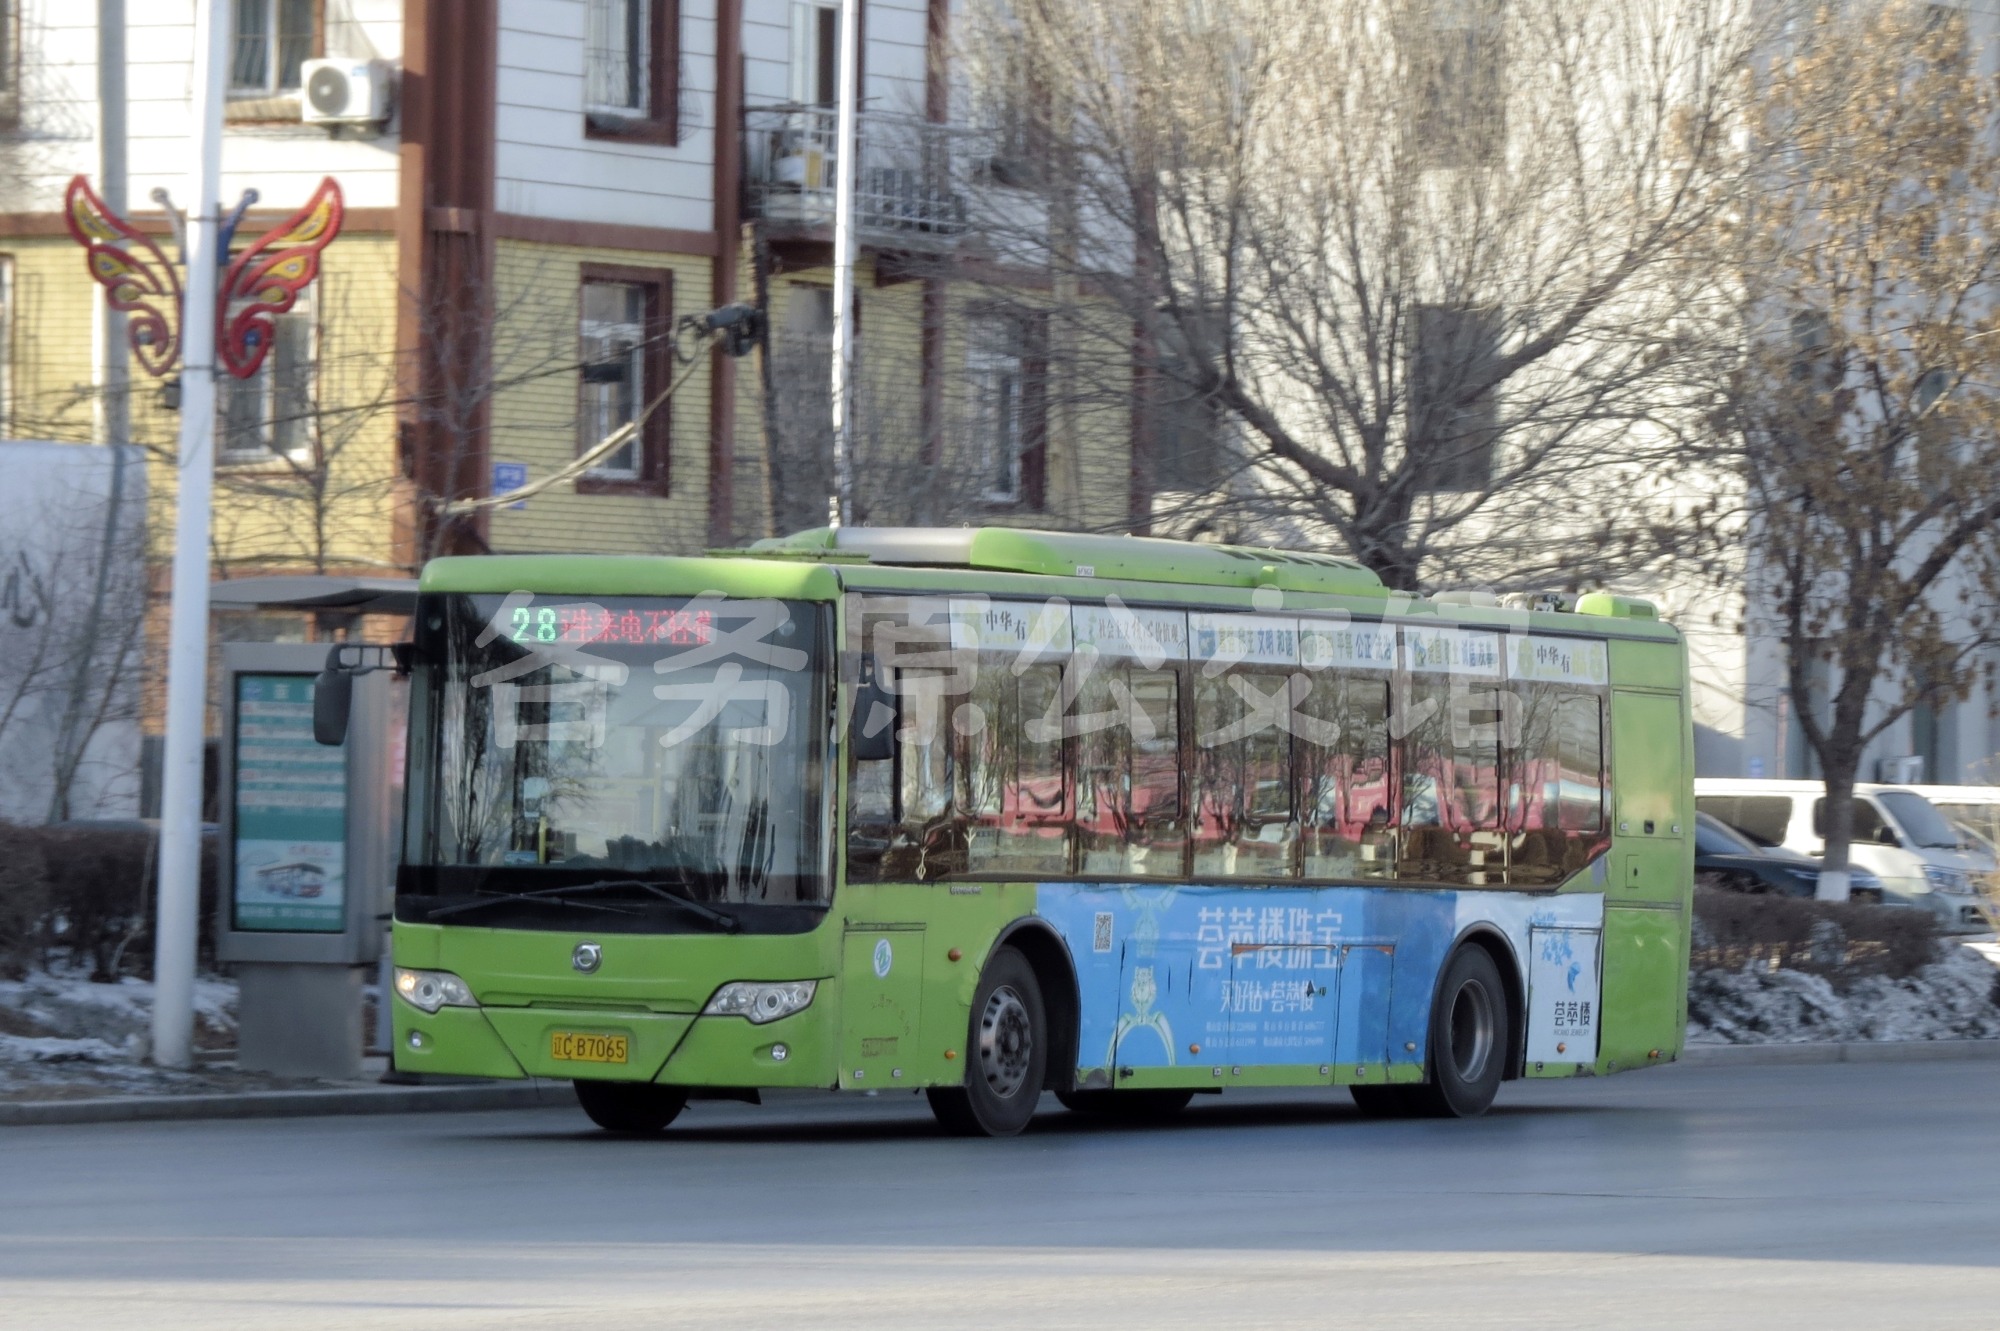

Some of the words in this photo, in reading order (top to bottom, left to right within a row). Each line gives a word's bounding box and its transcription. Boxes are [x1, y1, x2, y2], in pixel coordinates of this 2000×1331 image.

[512, 607, 556, 642] 28
[1196, 906, 1343, 969] 荟萃楼珠宝
[1555, 1001, 1591, 1026] 荟萃楼
